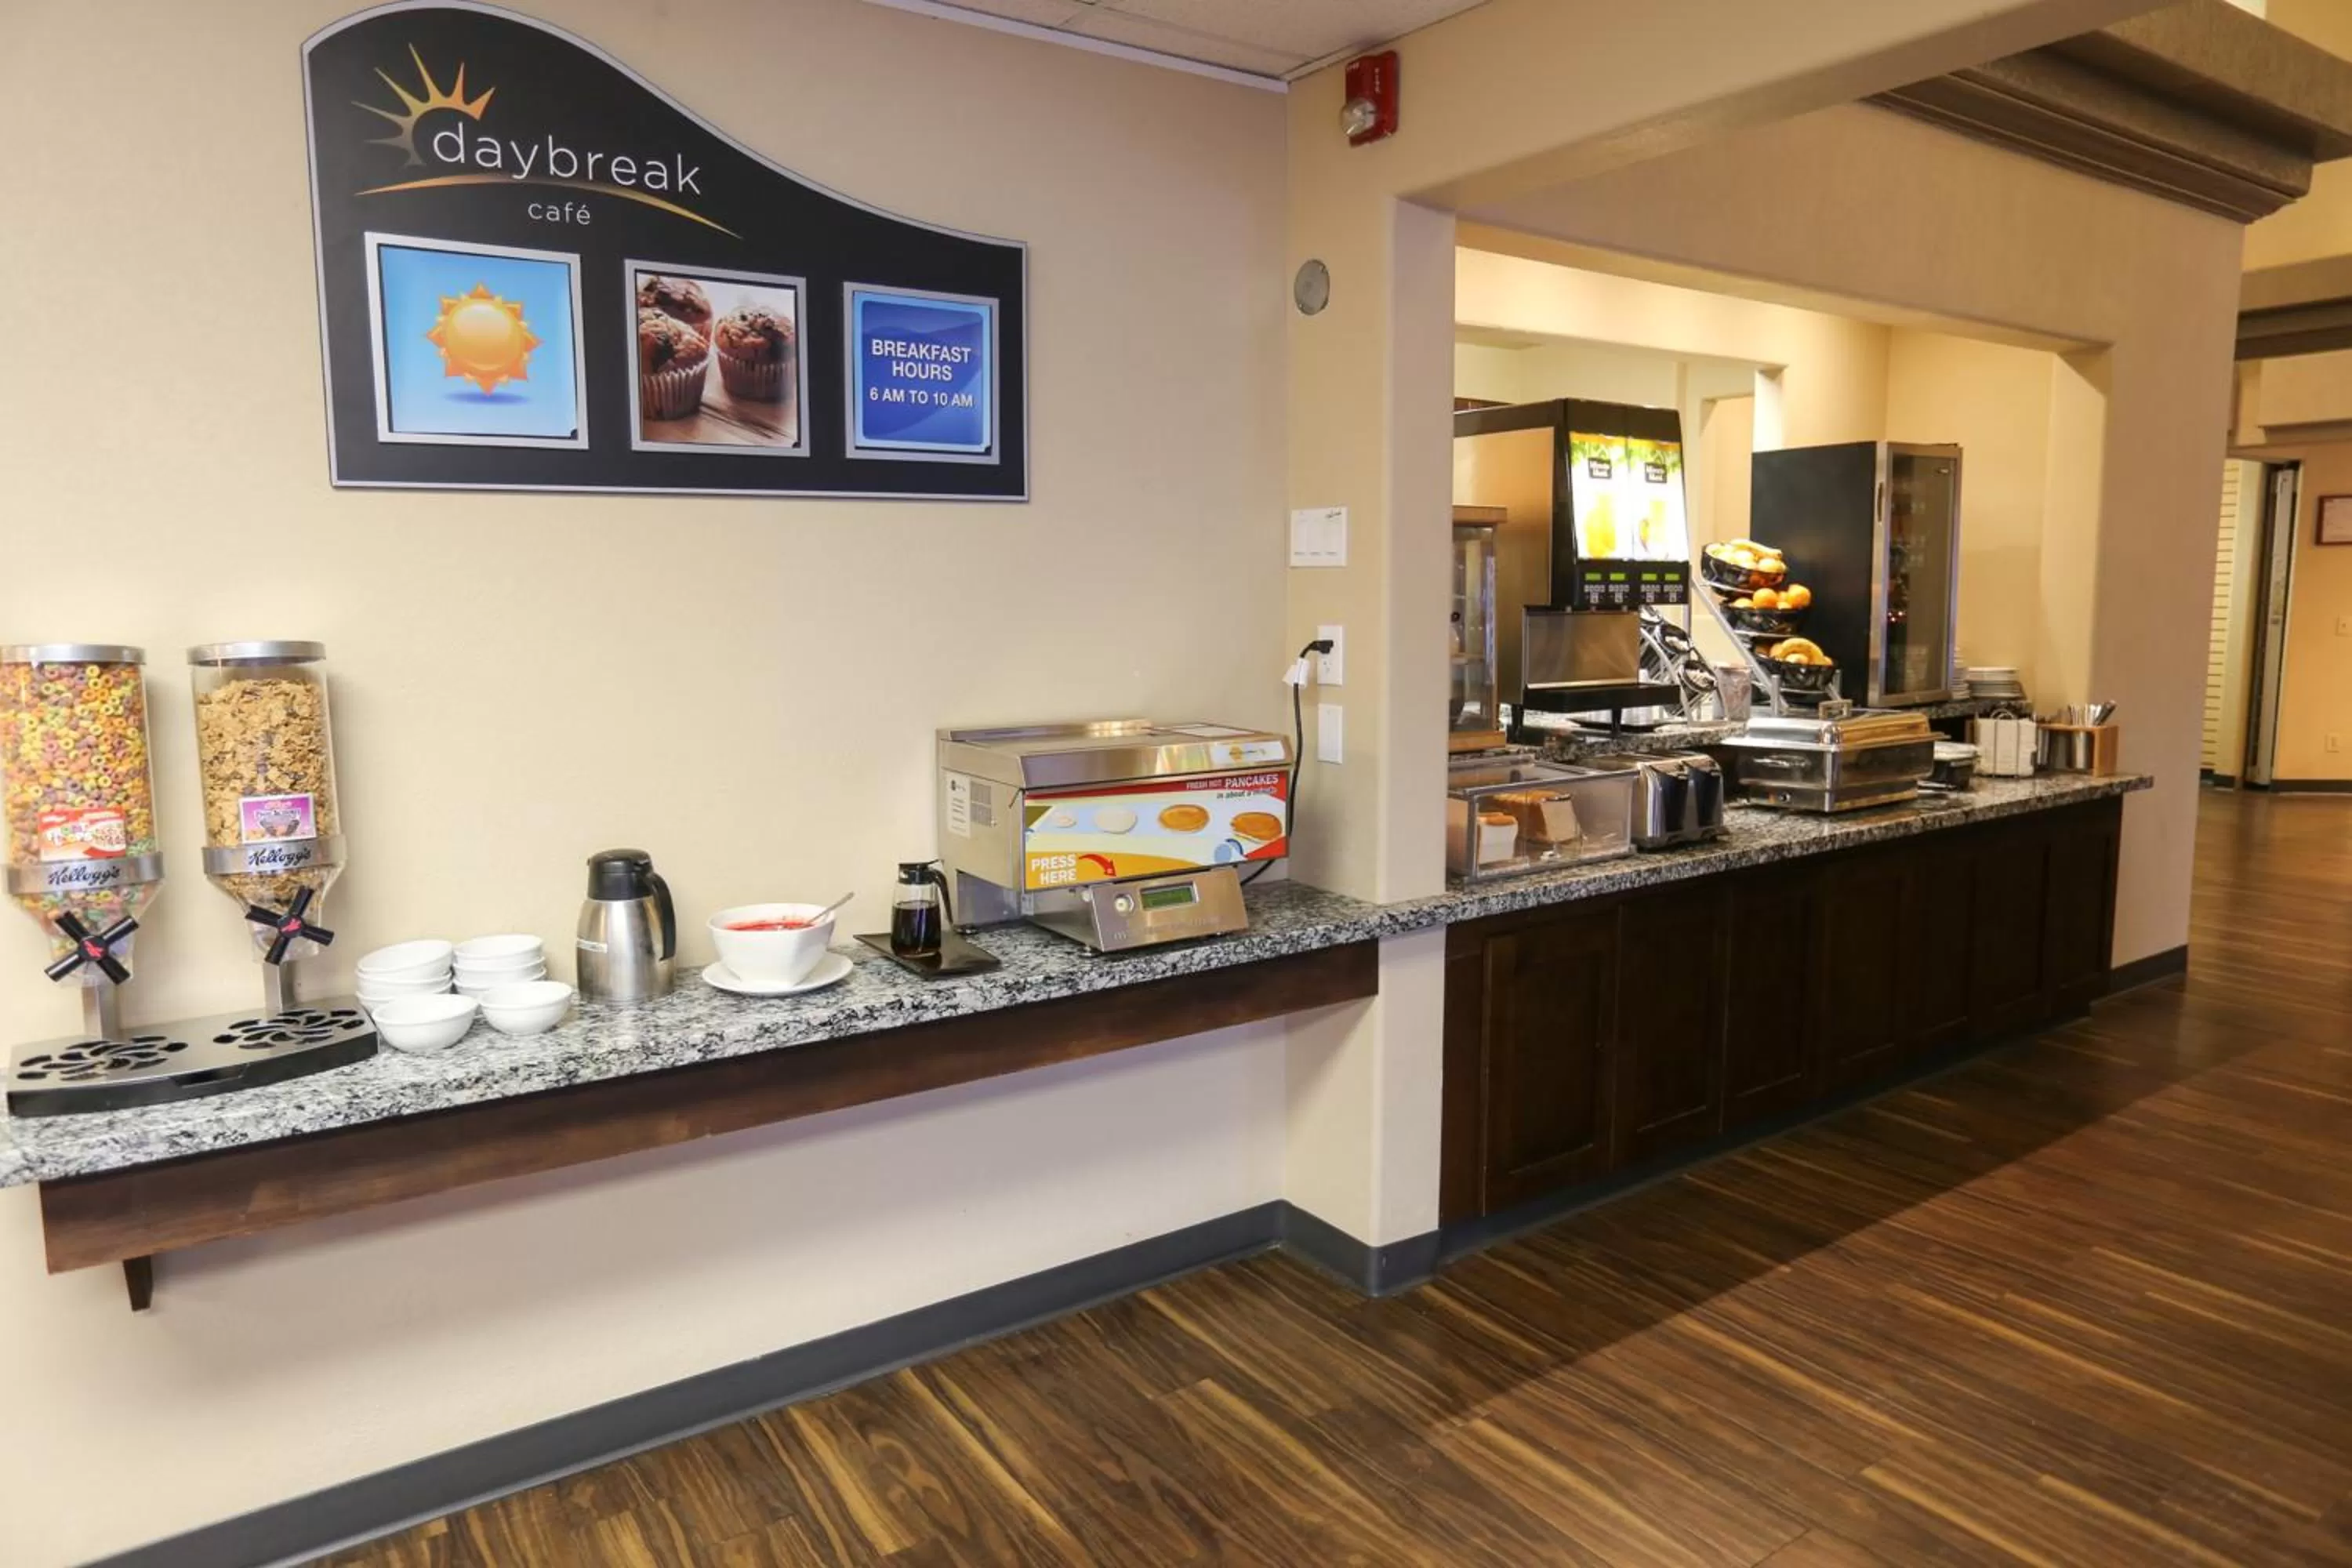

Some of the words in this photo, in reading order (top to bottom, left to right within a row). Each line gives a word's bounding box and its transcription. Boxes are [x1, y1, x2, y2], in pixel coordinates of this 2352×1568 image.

[433, 122, 701, 195] daybreak
[528, 201, 590, 226] café
[871, 339, 971, 363] BREAKFAST
[892, 360, 953, 381] HOURS
[869, 387, 879, 401] 6
[882, 388, 905, 402] AM
[909, 390, 928, 405] TO
[933, 392, 948, 405] 10
[951, 394, 973, 408] AM
[1225, 774, 1279, 789] PANCAKES
[249, 847, 311, 866] Kellogg's
[1031, 853, 1076, 872] PRESS
[48, 866, 121, 886] Kellogg's
[1040, 868, 1076, 885] HERE
